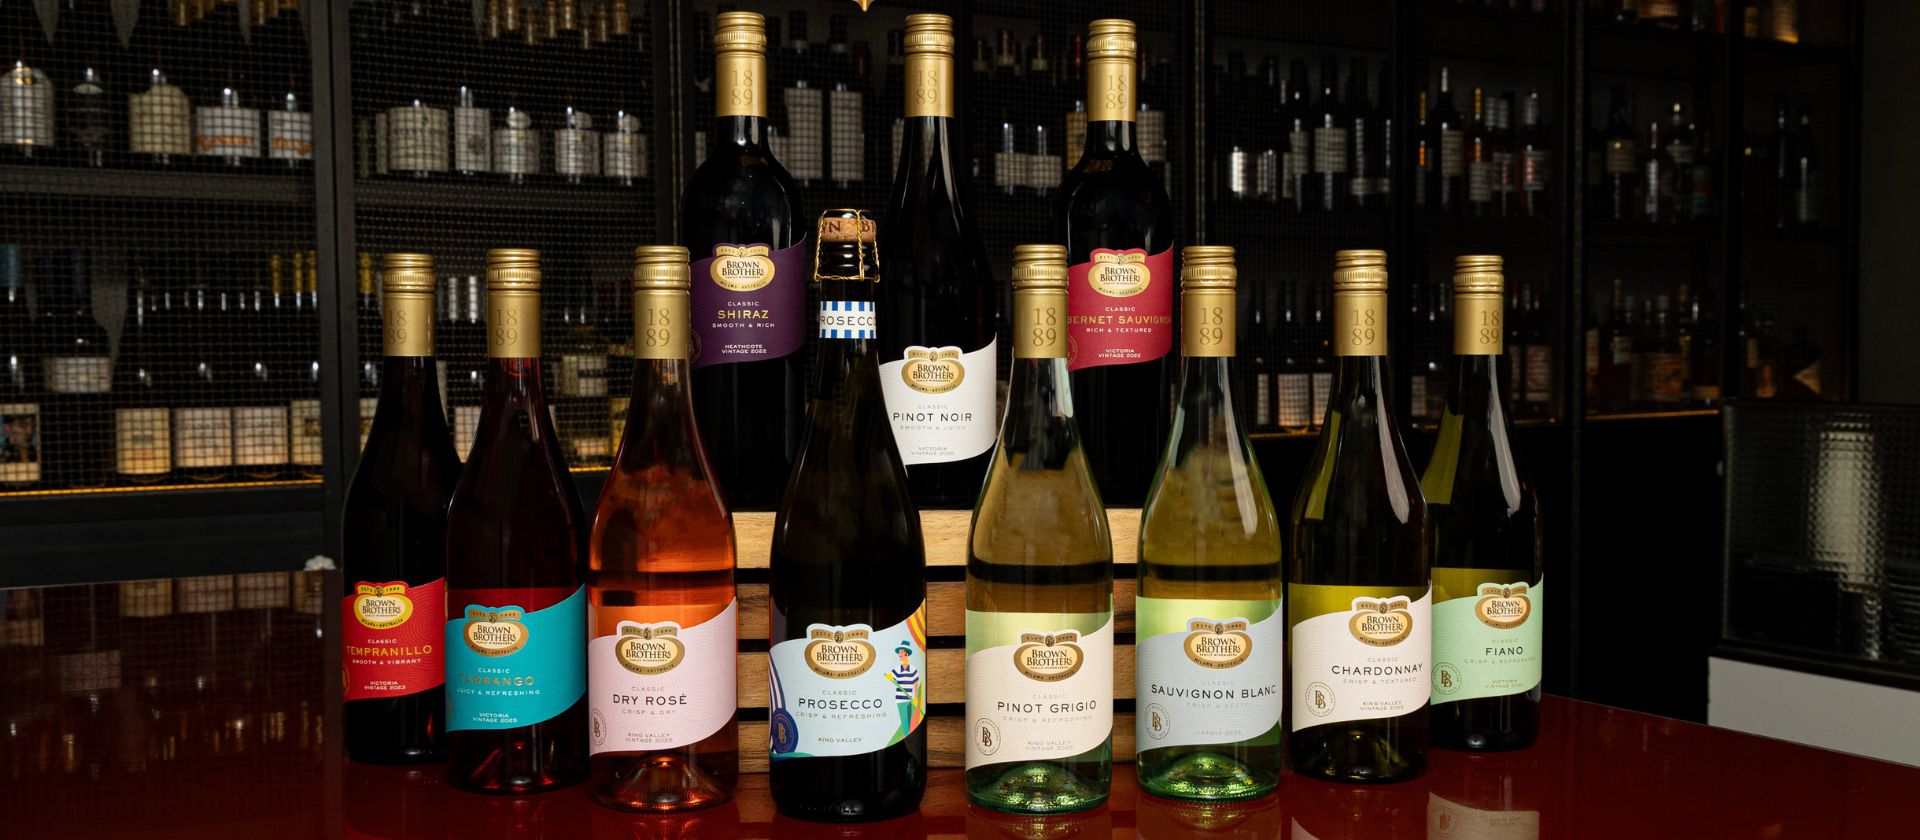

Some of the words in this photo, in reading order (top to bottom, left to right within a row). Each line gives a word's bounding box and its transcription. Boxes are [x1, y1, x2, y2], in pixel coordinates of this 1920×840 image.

[732, 70, 753, 87] 18
[917, 70, 937, 87] 18
[1106, 75, 1127, 92] 18
[731, 88, 753, 106] 89
[916, 88, 938, 106] 89
[1106, 93, 1126, 110] 89
[726, 260, 760, 269] BROWN
[721, 267, 765, 277] BROTHERS
[1104, 266, 1137, 275] BROWN
[1100, 273, 1141, 283] BROTHERS
[387, 310, 407, 327] 18
[496, 309, 518, 326] 18
[648, 308, 670, 326] 18
[717, 309, 770, 320] SHIRAZ
[1033, 307, 1057, 326] 18
[1200, 307, 1224, 325] 18
[1352, 309, 1375, 326] 18
[1481, 310, 1499, 326] 18
[387, 328, 407, 346] 89
[496, 328, 518, 346] 89
[646, 328, 670, 347] 89
[1033, 327, 1057, 347] 89
[1199, 328, 1224, 346] 89
[1352, 328, 1375, 346] 89
[1480, 327, 1499, 345] 89
[917, 363, 950, 372] BROWN
[912, 371, 955, 380] BROTHERS
[893, 412, 934, 422] PINOT
[940, 412, 973, 422] NOIR
[365, 599, 396, 607] BROWN
[1491, 600, 1521, 608] BROWN
[362, 606, 401, 614] BROTHERS
[1366, 615, 1399, 624] BROWN
[477, 625, 512, 634] BROWN
[1361, 622, 1404, 632] BROTHERS
[473, 632, 517, 642] BROTHERS
[1201, 636, 1236, 646] BROWN
[346, 645, 433, 657] TEMPRANILLO
[630, 641, 667, 651] BROWN
[821, 645, 859, 654] BROWN
[1196, 644, 1241, 654] BROTHERS
[1485, 646, 1524, 656] FIANO
[626, 649, 672, 660] BROTHERS
[816, 651, 864, 662] BROTHERS
[1032, 649, 1068, 659] BROWN
[387, 658, 422, 666] VIBRANT
[1026, 657, 1073, 667] BROTHERS
[1331, 663, 1423, 676] CHARDONNAY
[458, 673, 536, 687] TARRANGO
[1381, 676, 1417, 684] TEXTURED
[485, 689, 541, 697] REFRESHING
[1151, 684, 1235, 699] SAUVIGNON
[1241, 684, 1277, 699] BLANC
[613, 693, 641, 705] DRY
[645, 693, 688, 706] ROSÉ
[798, 697, 884, 711] PROSECCO
[622, 708, 647, 716] CRISP
[997, 701, 1043, 713] PINOT
[1050, 700, 1097, 714] GRIGIO
[795, 711, 819, 719] CRISP
[831, 712, 888, 720] REFRESHING
[1002, 715, 1028, 723] CRISP
[1041, 715, 1092, 723] REFRESHING
